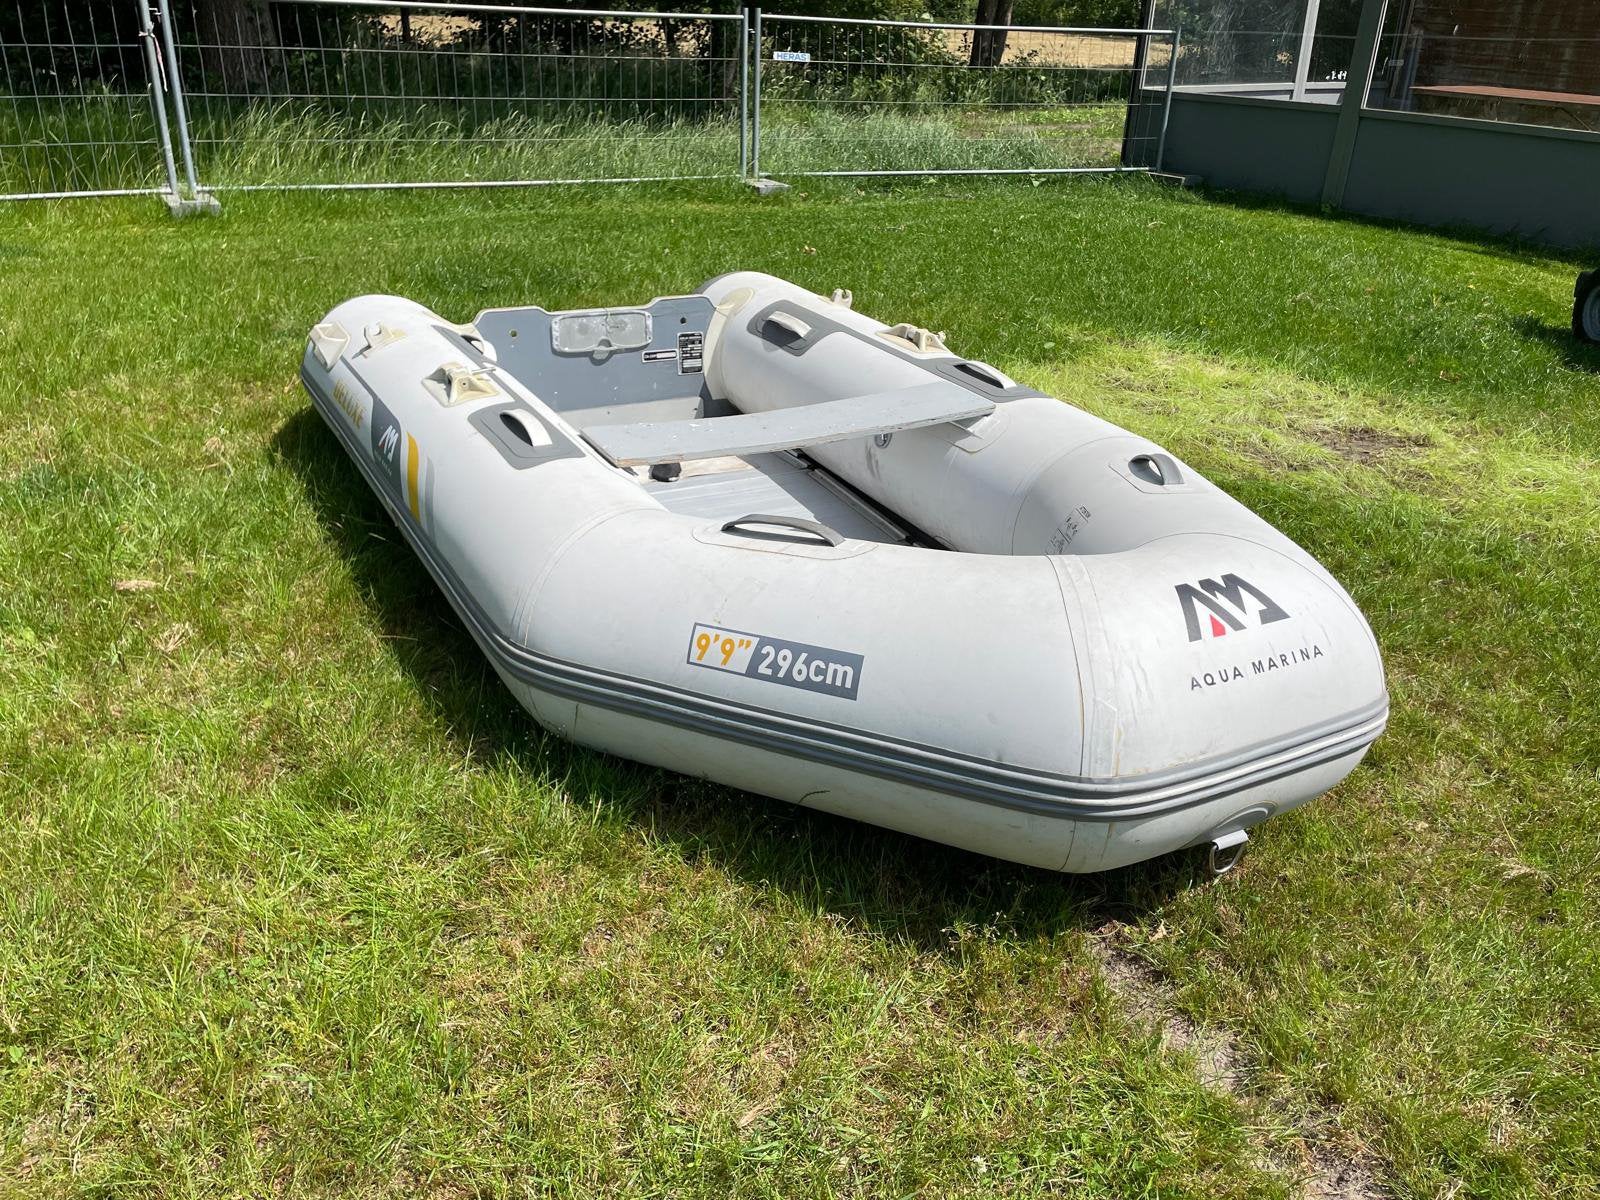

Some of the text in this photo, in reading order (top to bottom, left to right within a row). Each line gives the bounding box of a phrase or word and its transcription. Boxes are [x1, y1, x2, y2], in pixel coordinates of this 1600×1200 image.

[776, 52, 807, 61] HERAS
[757, 645, 854, 689] 296cm
[1190, 645, 1324, 691] AQUA MARINA
